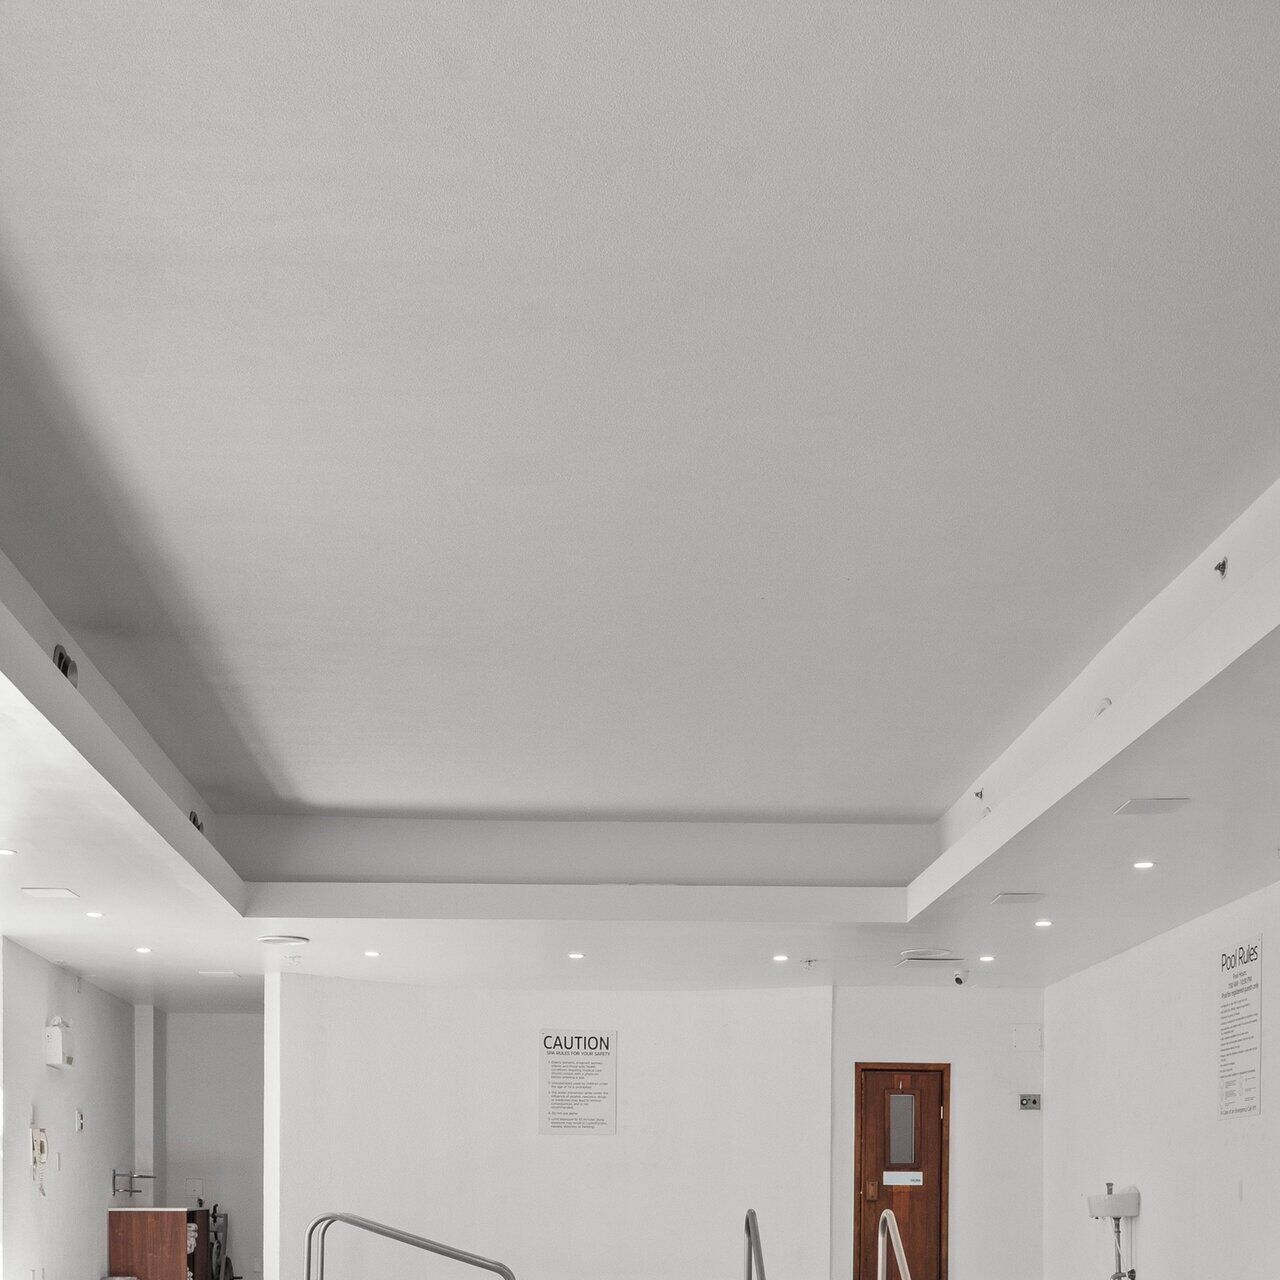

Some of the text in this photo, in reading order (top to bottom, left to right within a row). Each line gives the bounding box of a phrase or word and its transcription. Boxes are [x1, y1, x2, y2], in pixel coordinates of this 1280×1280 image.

[1221, 944, 1258, 972] Pool Rules
[543, 1035, 610, 1050] CAUTION
